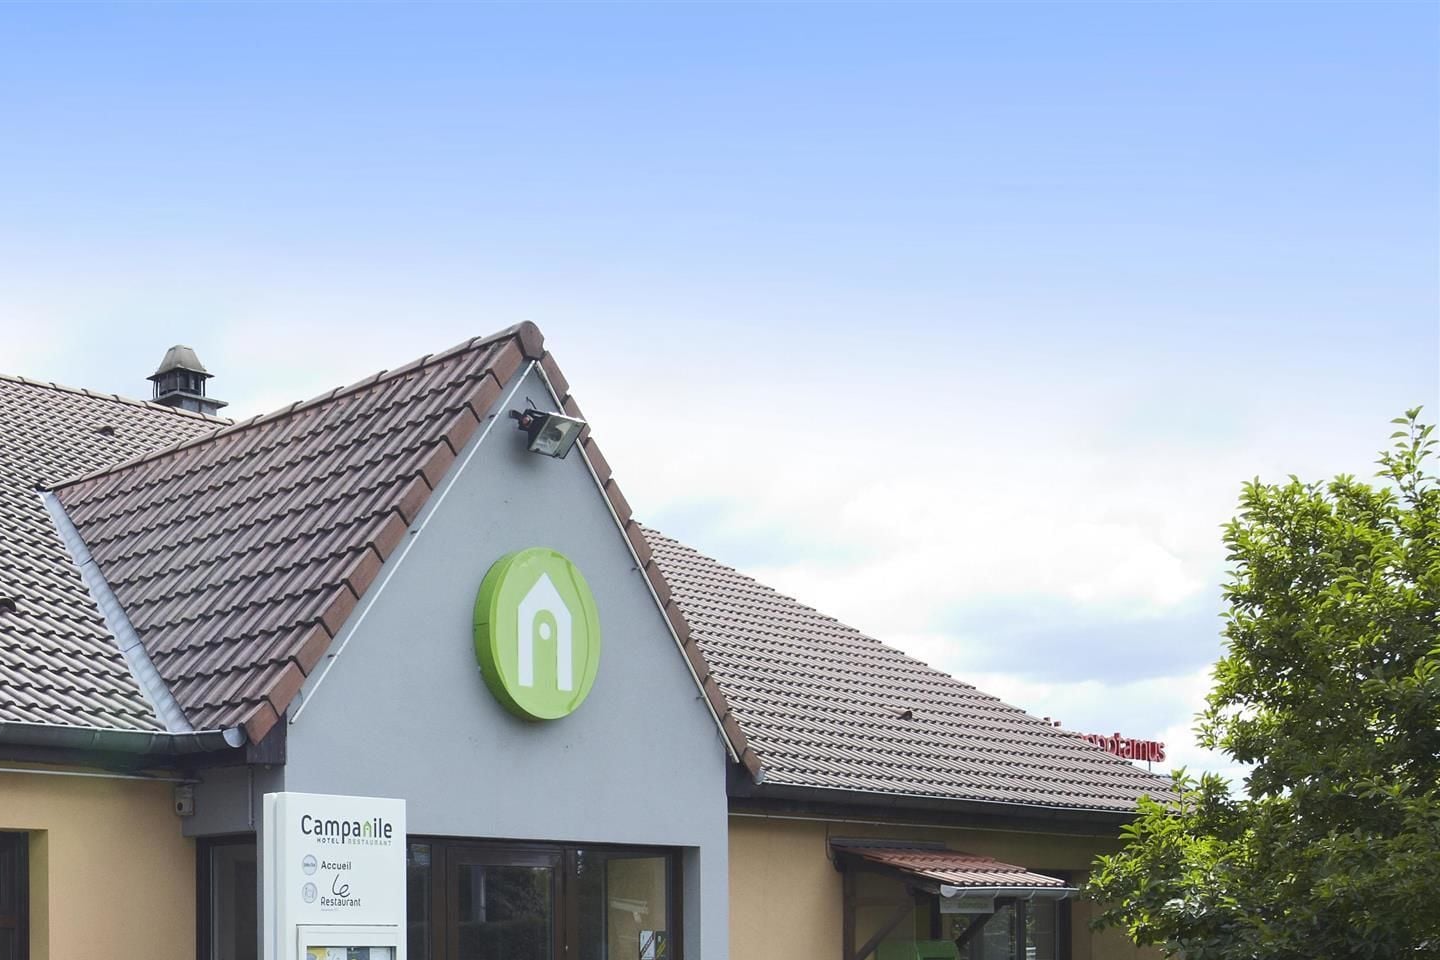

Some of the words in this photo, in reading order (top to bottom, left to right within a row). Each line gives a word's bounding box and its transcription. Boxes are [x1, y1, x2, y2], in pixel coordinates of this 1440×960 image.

[301, 814, 392, 844] Campanile
[317, 837, 340, 845] HOTEL
[347, 838, 392, 847] RESTAURANT
[321, 860, 352, 871] Accueil
[320, 896, 361, 907] Restaurant
